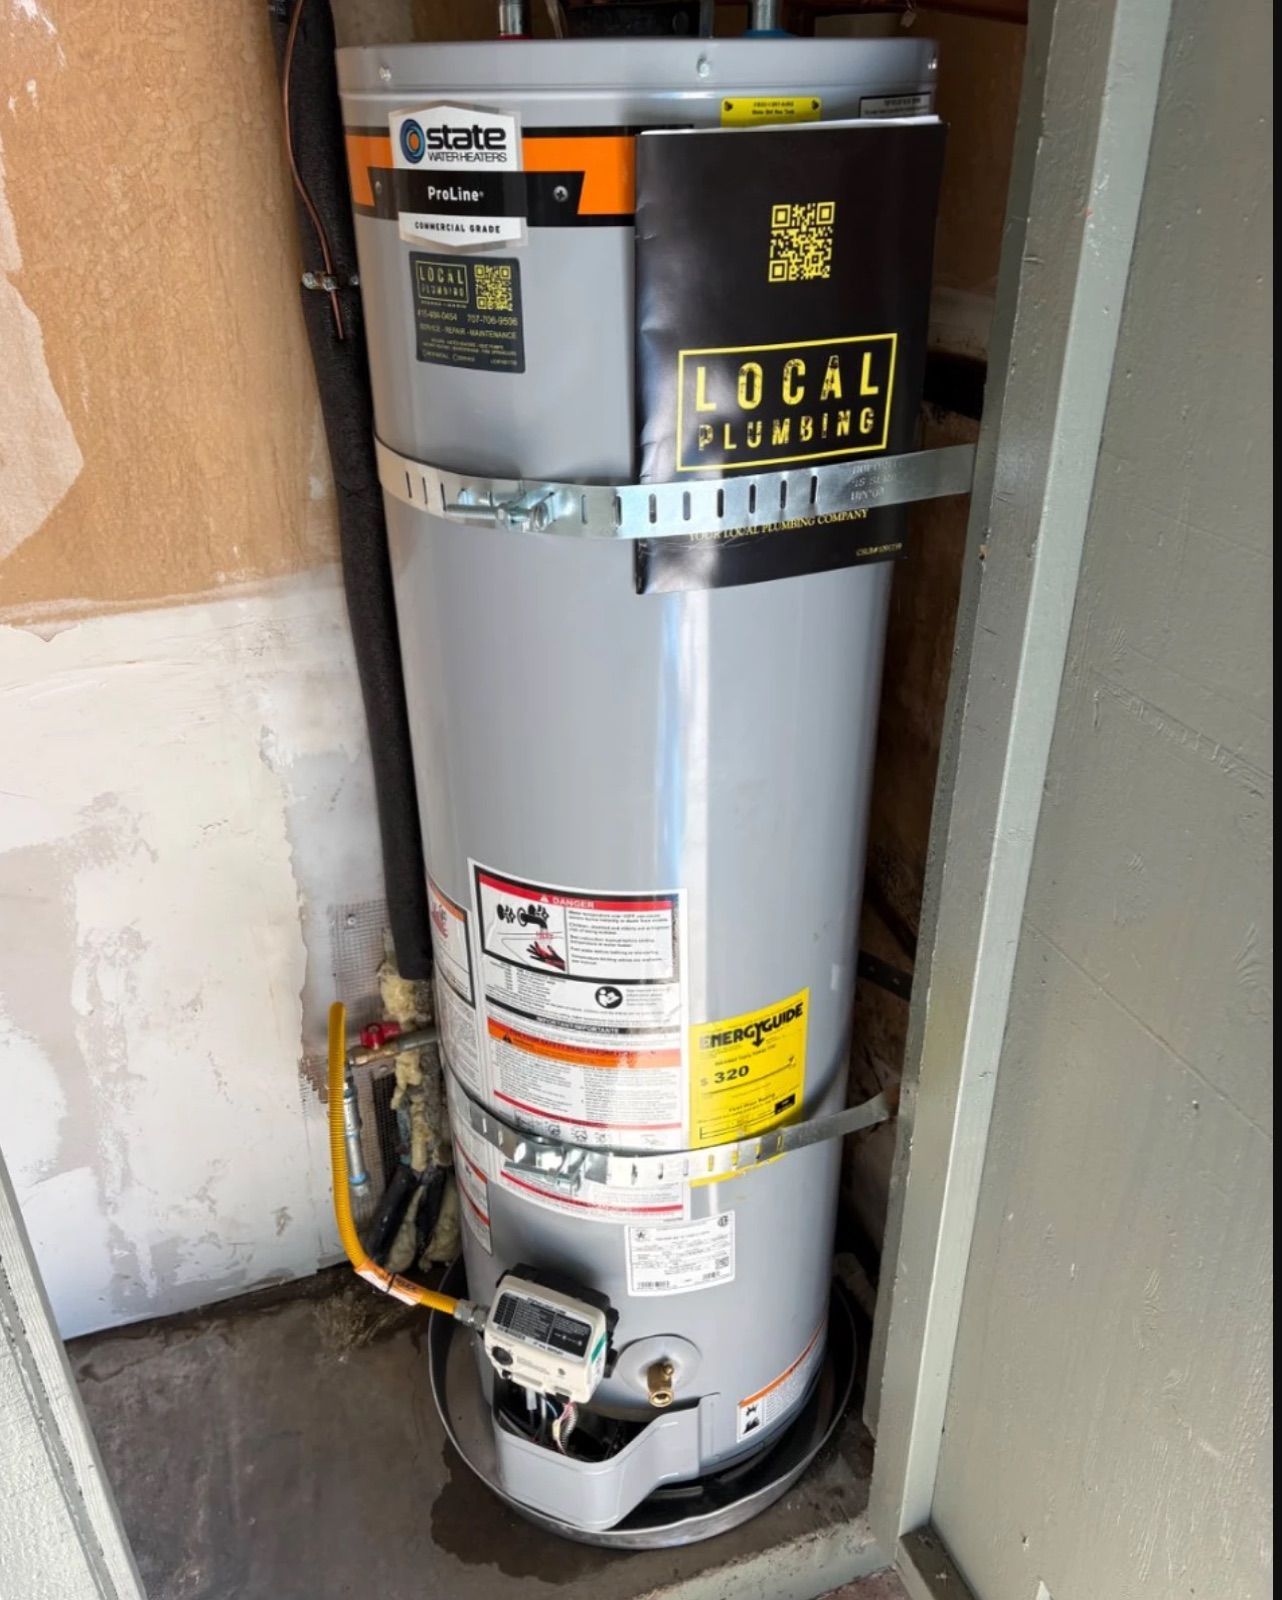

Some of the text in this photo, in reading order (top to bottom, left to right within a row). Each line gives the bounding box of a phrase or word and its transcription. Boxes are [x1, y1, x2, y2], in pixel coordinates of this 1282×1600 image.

[426, 125, 507, 150] state
[415, 221, 501, 233] COMMERCIAL GRADE
[420, 266, 464, 284] LOCAL
[696, 352, 879, 412] LOCAL
[699, 407, 875, 451] PLUMBING
[723, 523, 760, 539] LOCAL
[761, 515, 816, 534] PLUMBING
[817, 508, 869, 526] COMPANY
[552, 896, 596, 908] DANGER
[714, 1064, 750, 1085] 320
